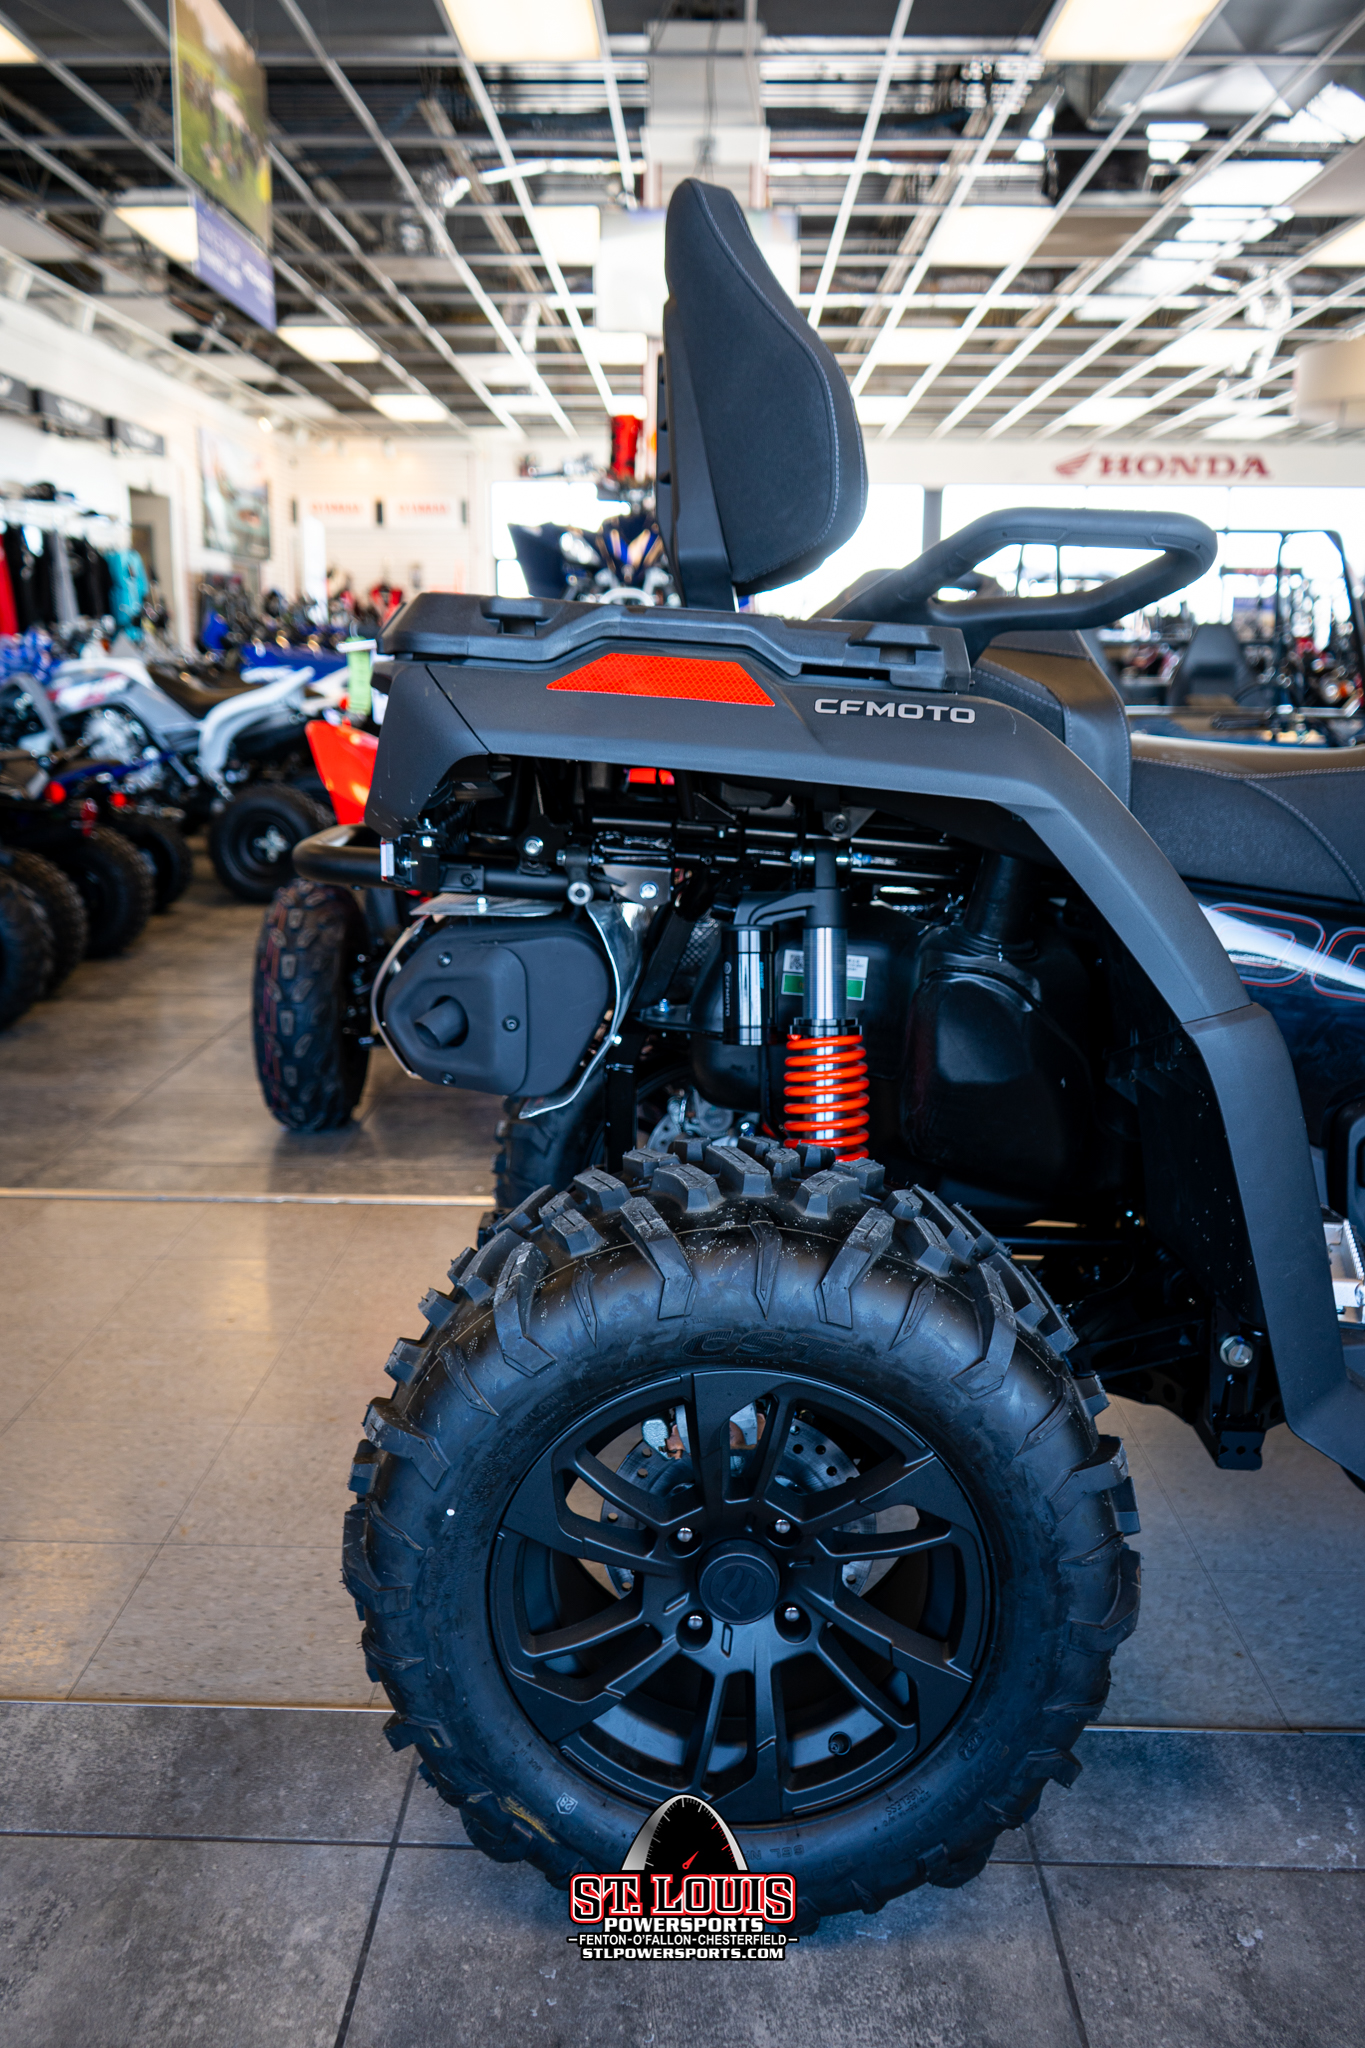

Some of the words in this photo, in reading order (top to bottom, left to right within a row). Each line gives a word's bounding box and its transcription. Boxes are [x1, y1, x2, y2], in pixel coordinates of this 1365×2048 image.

[1099, 454, 1269, 478] HONDA
[814, 698, 976, 724] CFMOTO
[681, 1329, 848, 1364] CST
[558, 1796, 574, 1811] 28
[885, 1785, 925, 1816] TUBELESS
